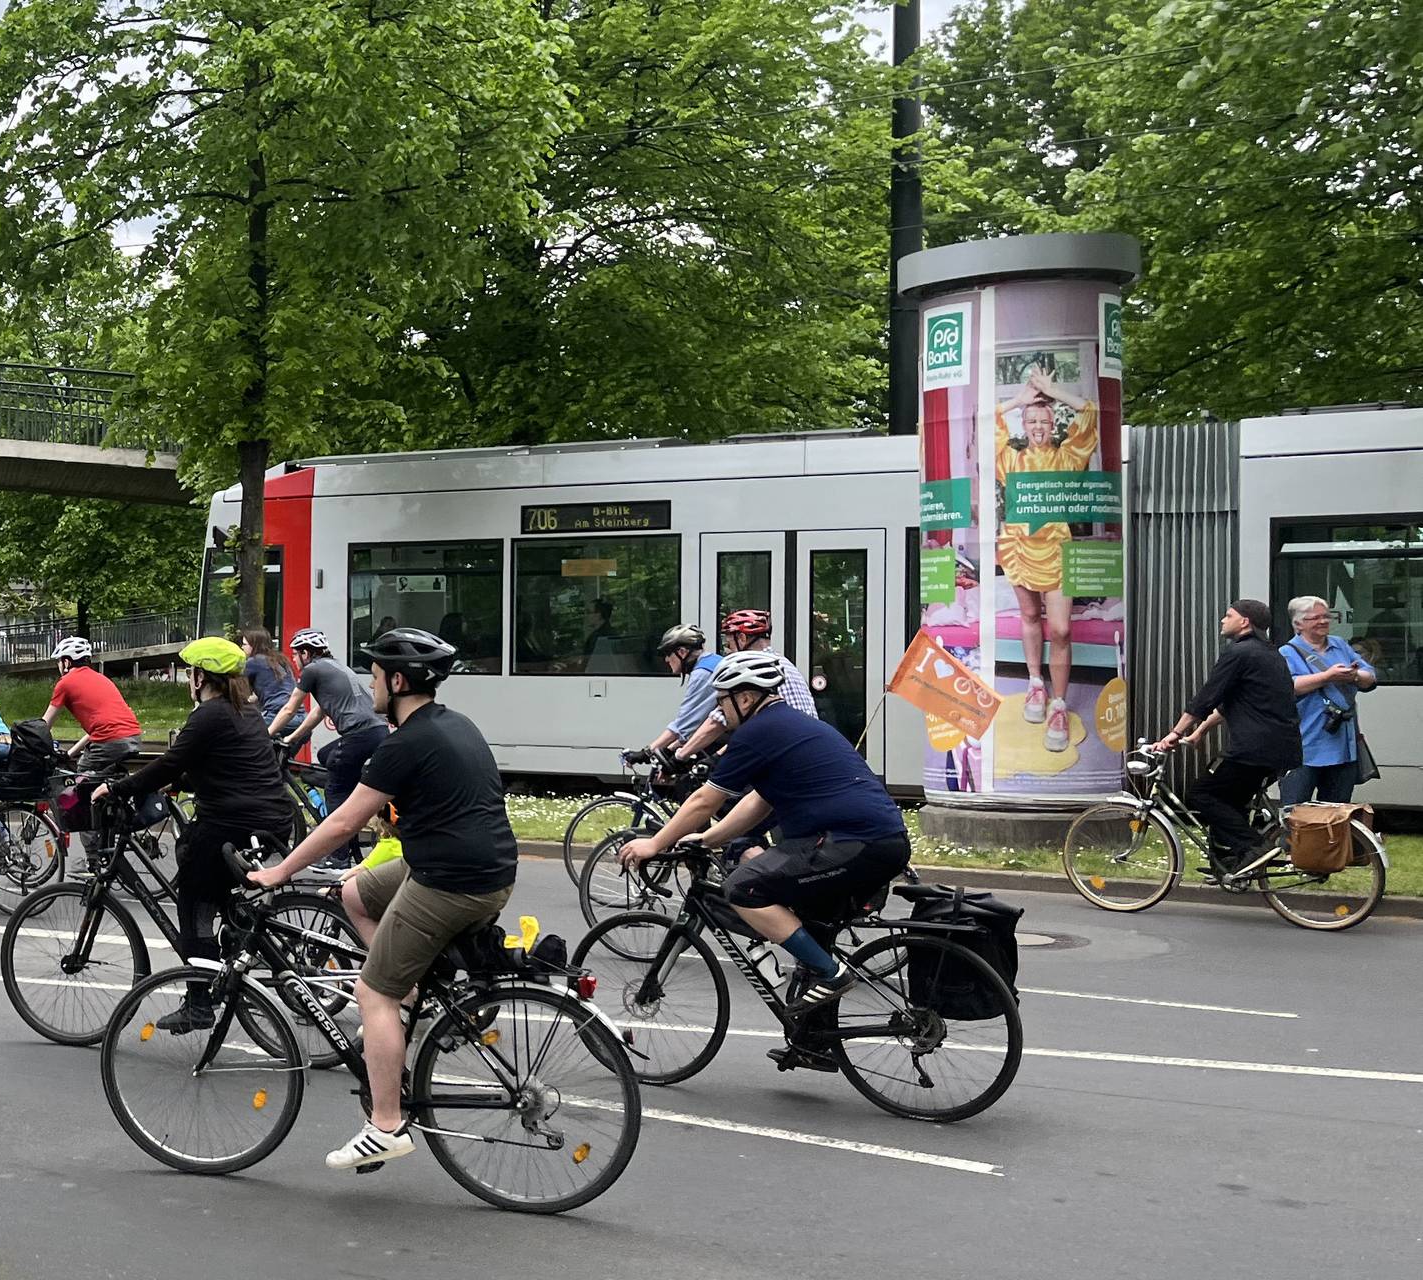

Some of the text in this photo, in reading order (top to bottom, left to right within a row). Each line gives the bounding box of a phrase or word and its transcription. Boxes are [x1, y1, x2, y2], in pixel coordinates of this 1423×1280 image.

[928, 347, 959, 366] Bank
[1016, 481, 1063, 491] Energetisch
[1065, 481, 1081, 489] oder
[1016, 493, 1044, 503] Jetzt
[1045, 492, 1094, 502] individuell
[528, 506, 630, 530] 706 D-Bilk
[1016, 504, 1066, 514] umbauen
[1068, 504, 1089, 513] oder
[575, 517, 650, 529] Am Steinberg
[915, 647, 936, 673] I
[713, 927, 776, 1002] SPECIALIZED
[293, 985, 350, 1051] PEGASUS
